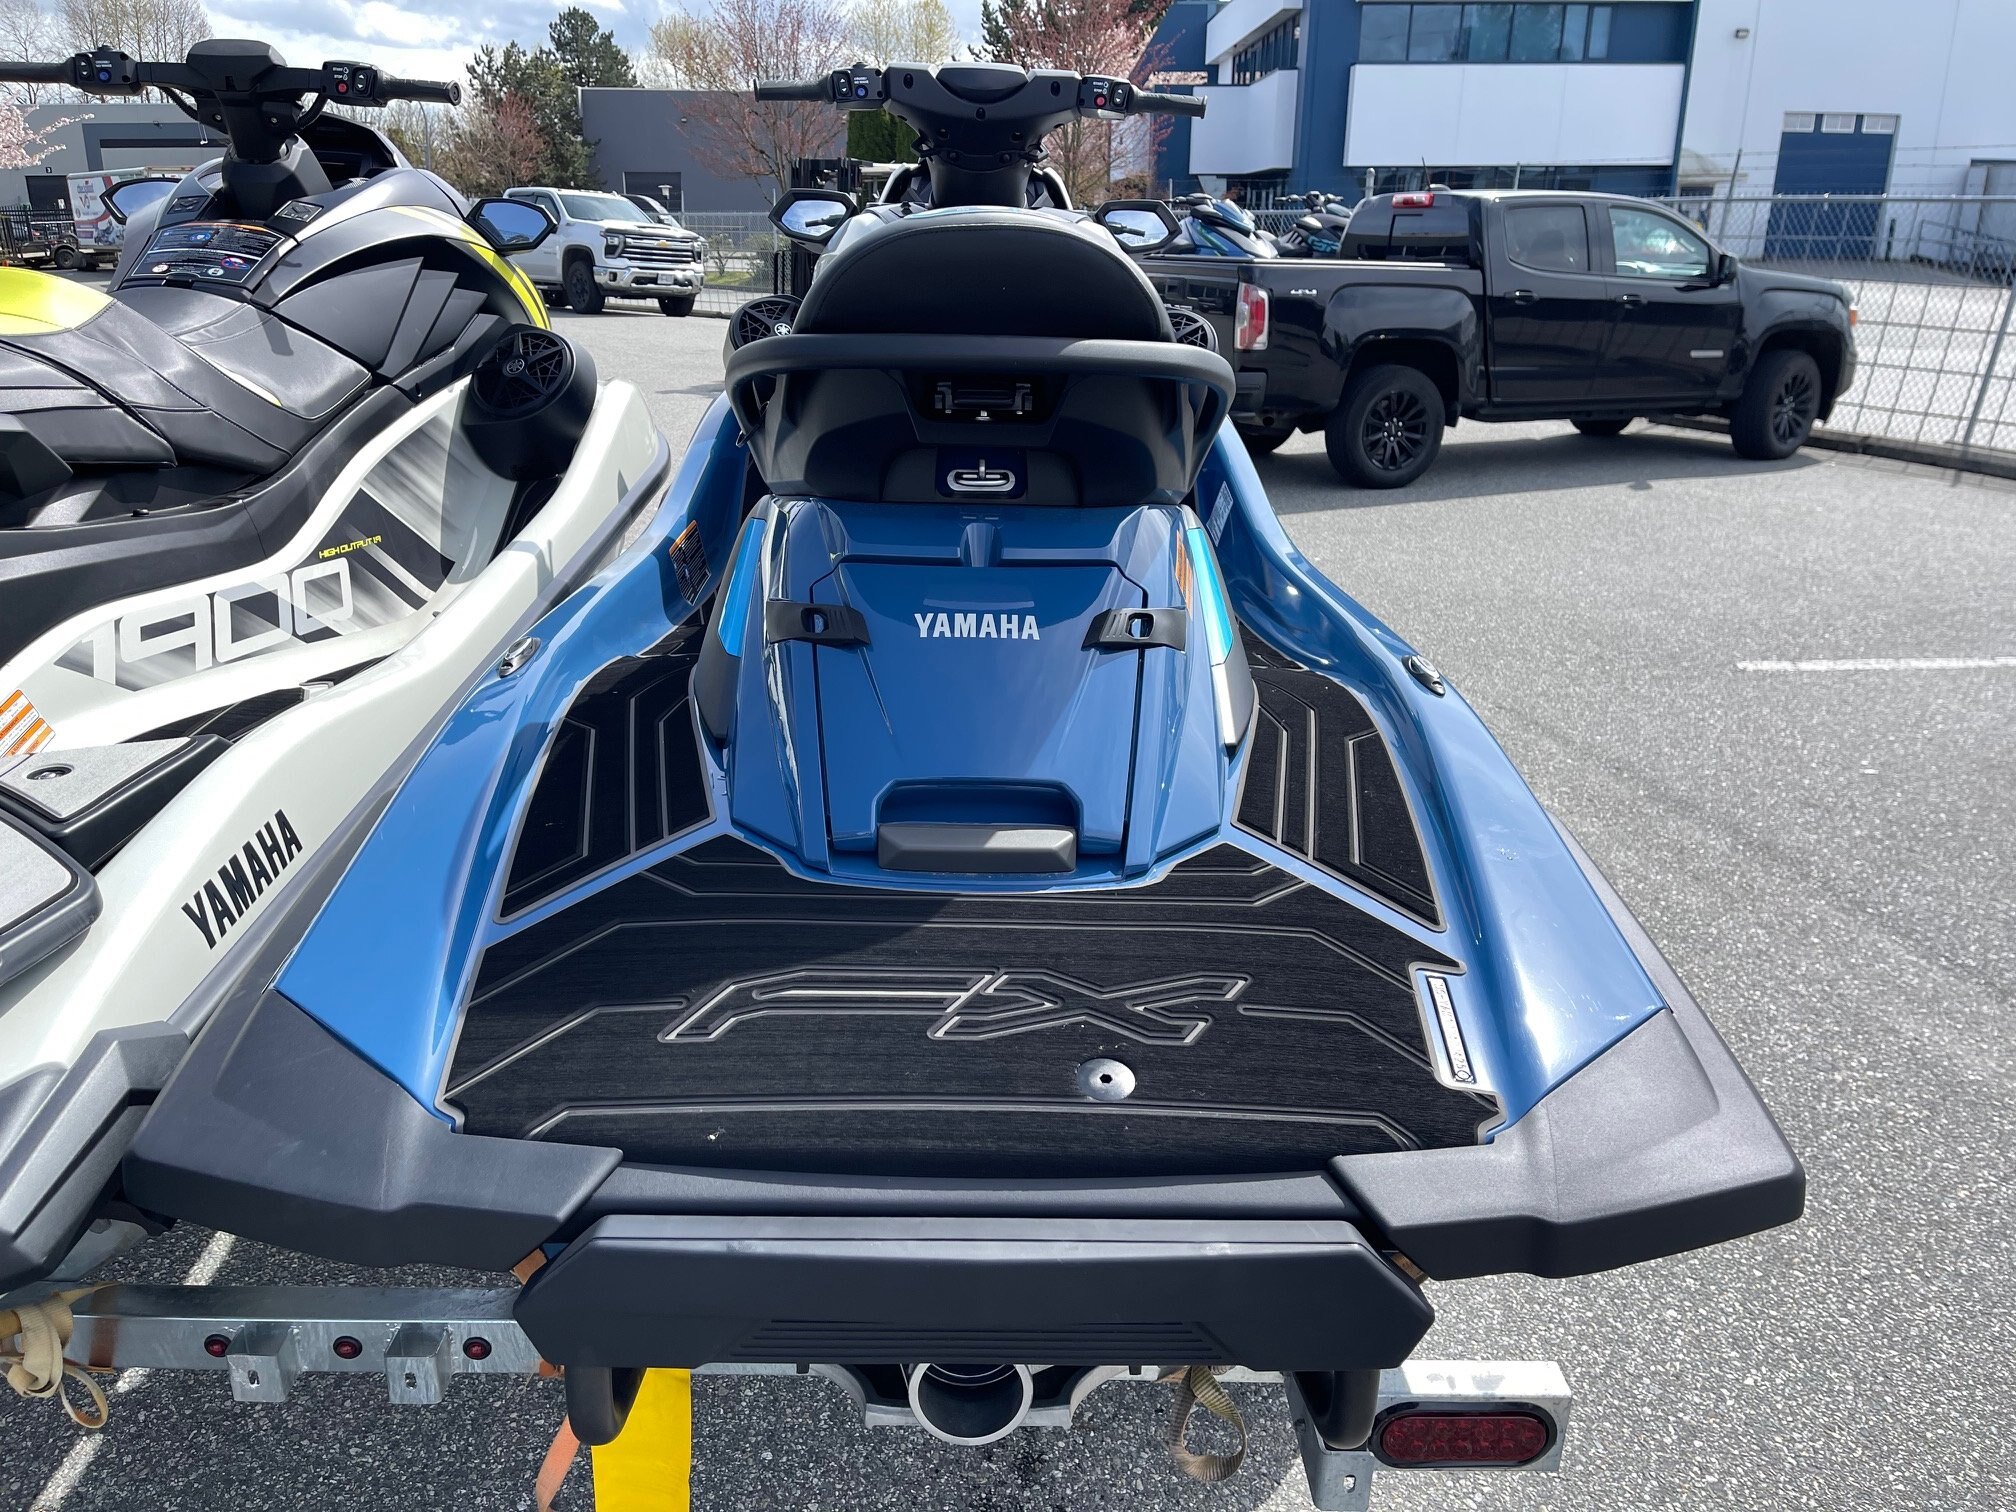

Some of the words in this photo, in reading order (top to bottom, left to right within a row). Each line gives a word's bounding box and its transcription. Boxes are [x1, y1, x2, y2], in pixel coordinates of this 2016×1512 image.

[319, 546, 340, 559] HIGH
[340, 537, 372, 553] OUTPUT
[914, 613, 1040, 641] YAMAHA
[181, 809, 304, 951] YAMAHA
[657, 965, 1254, 1046] FX
